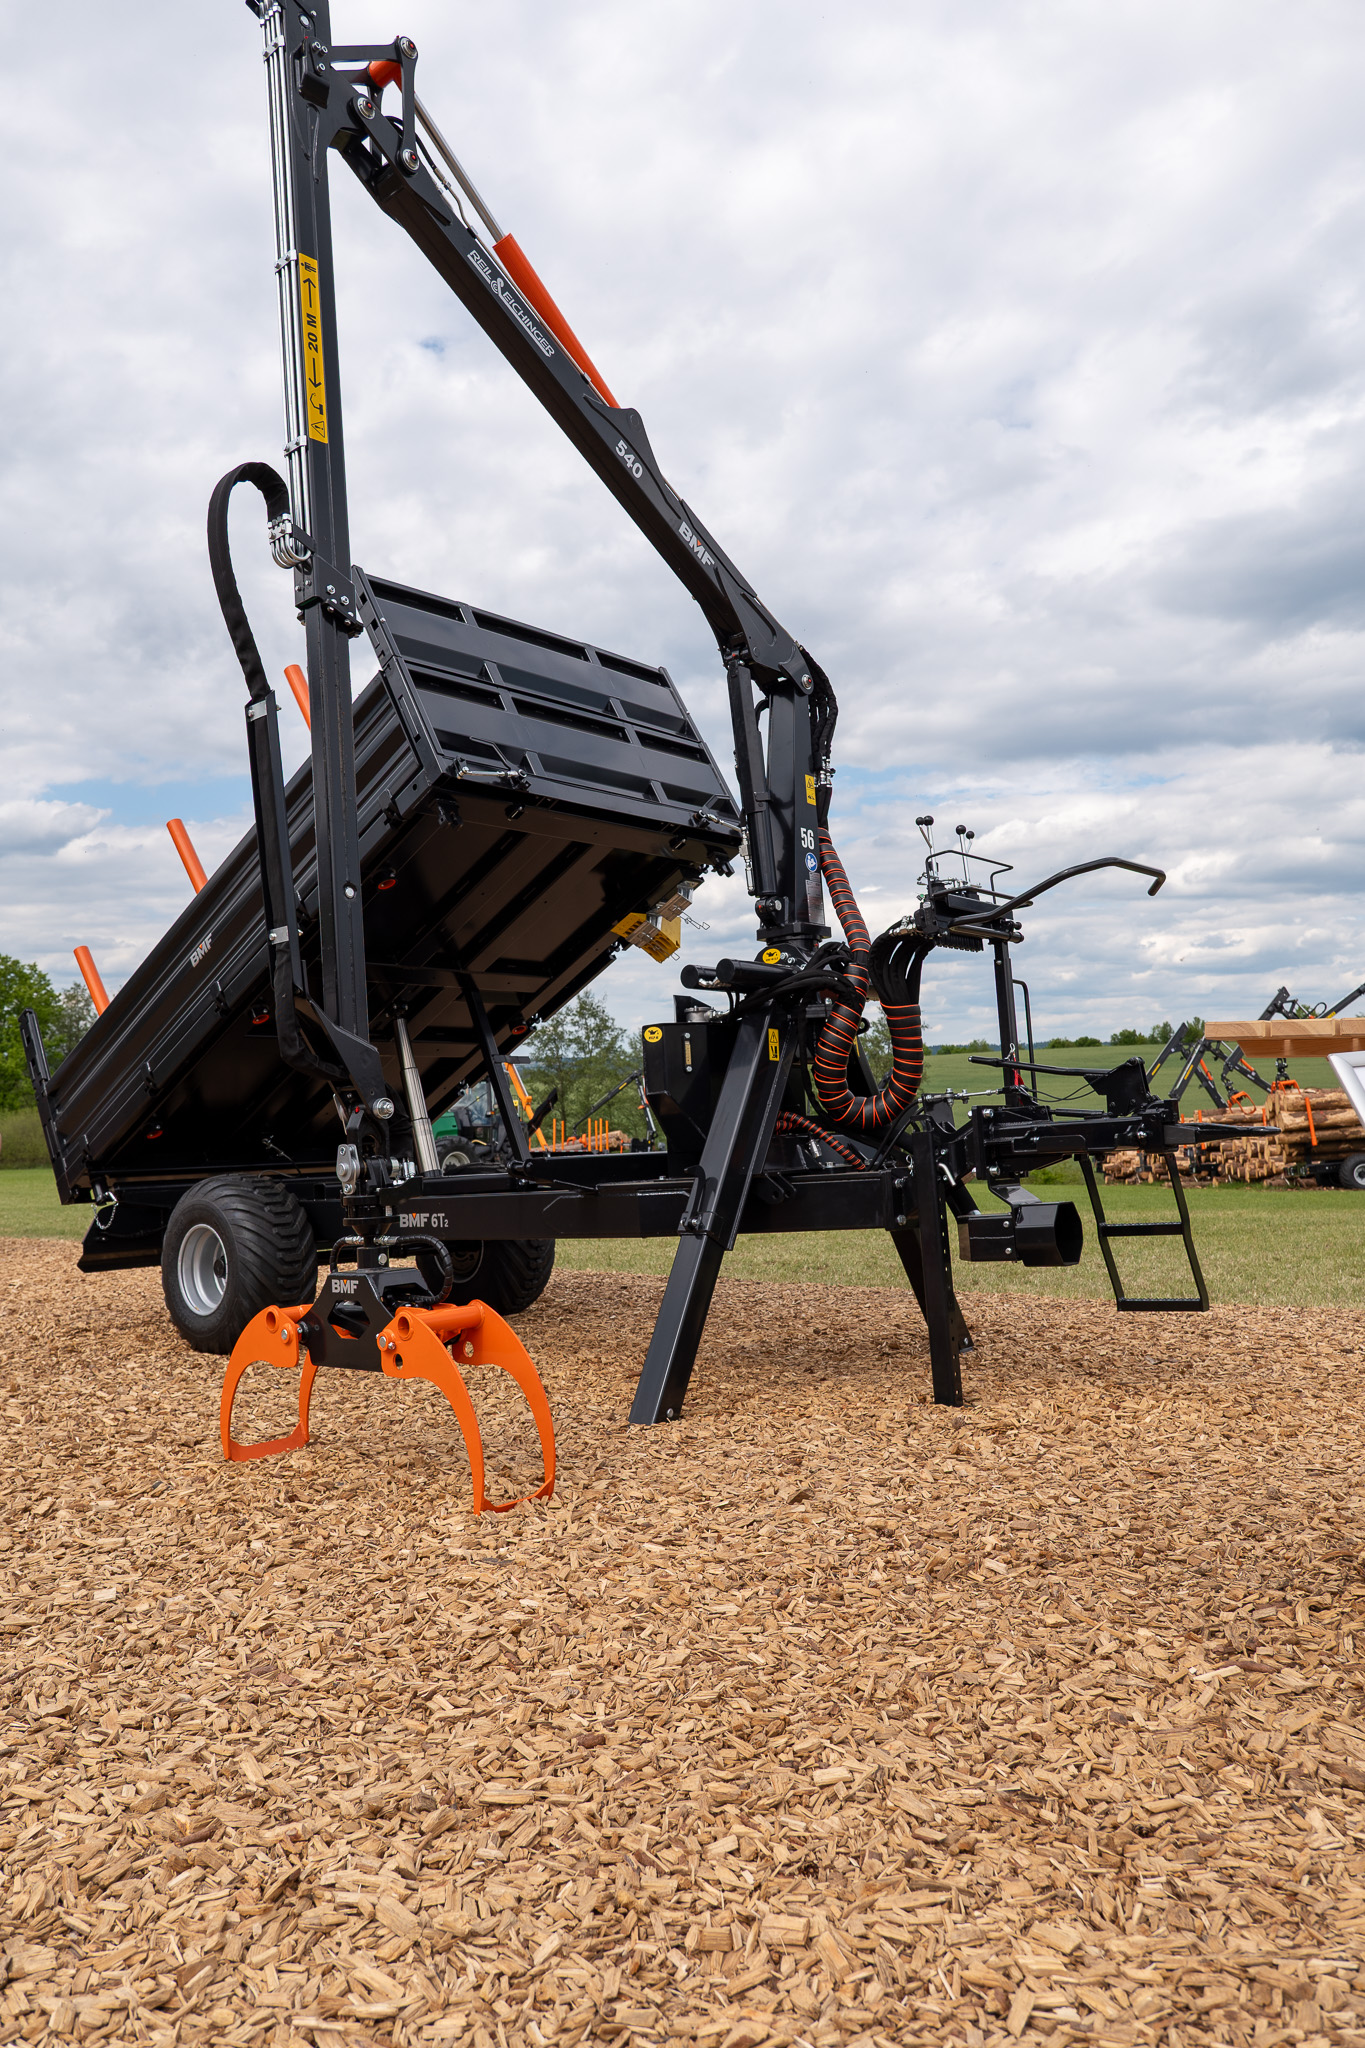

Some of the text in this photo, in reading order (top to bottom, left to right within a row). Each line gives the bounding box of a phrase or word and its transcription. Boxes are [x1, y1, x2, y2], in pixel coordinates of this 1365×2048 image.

[469, 250, 492, 280] REIL
[503, 291, 555, 357] EICHINGER
[306, 313, 319, 353] 20 M
[615, 440, 643, 478] 540
[678, 521, 715, 566] BMF
[800, 827, 815, 850] 56
[190, 932, 212, 968] BMF
[400, 1212, 430, 1228] BMF
[331, 1279, 359, 1294] BMF
